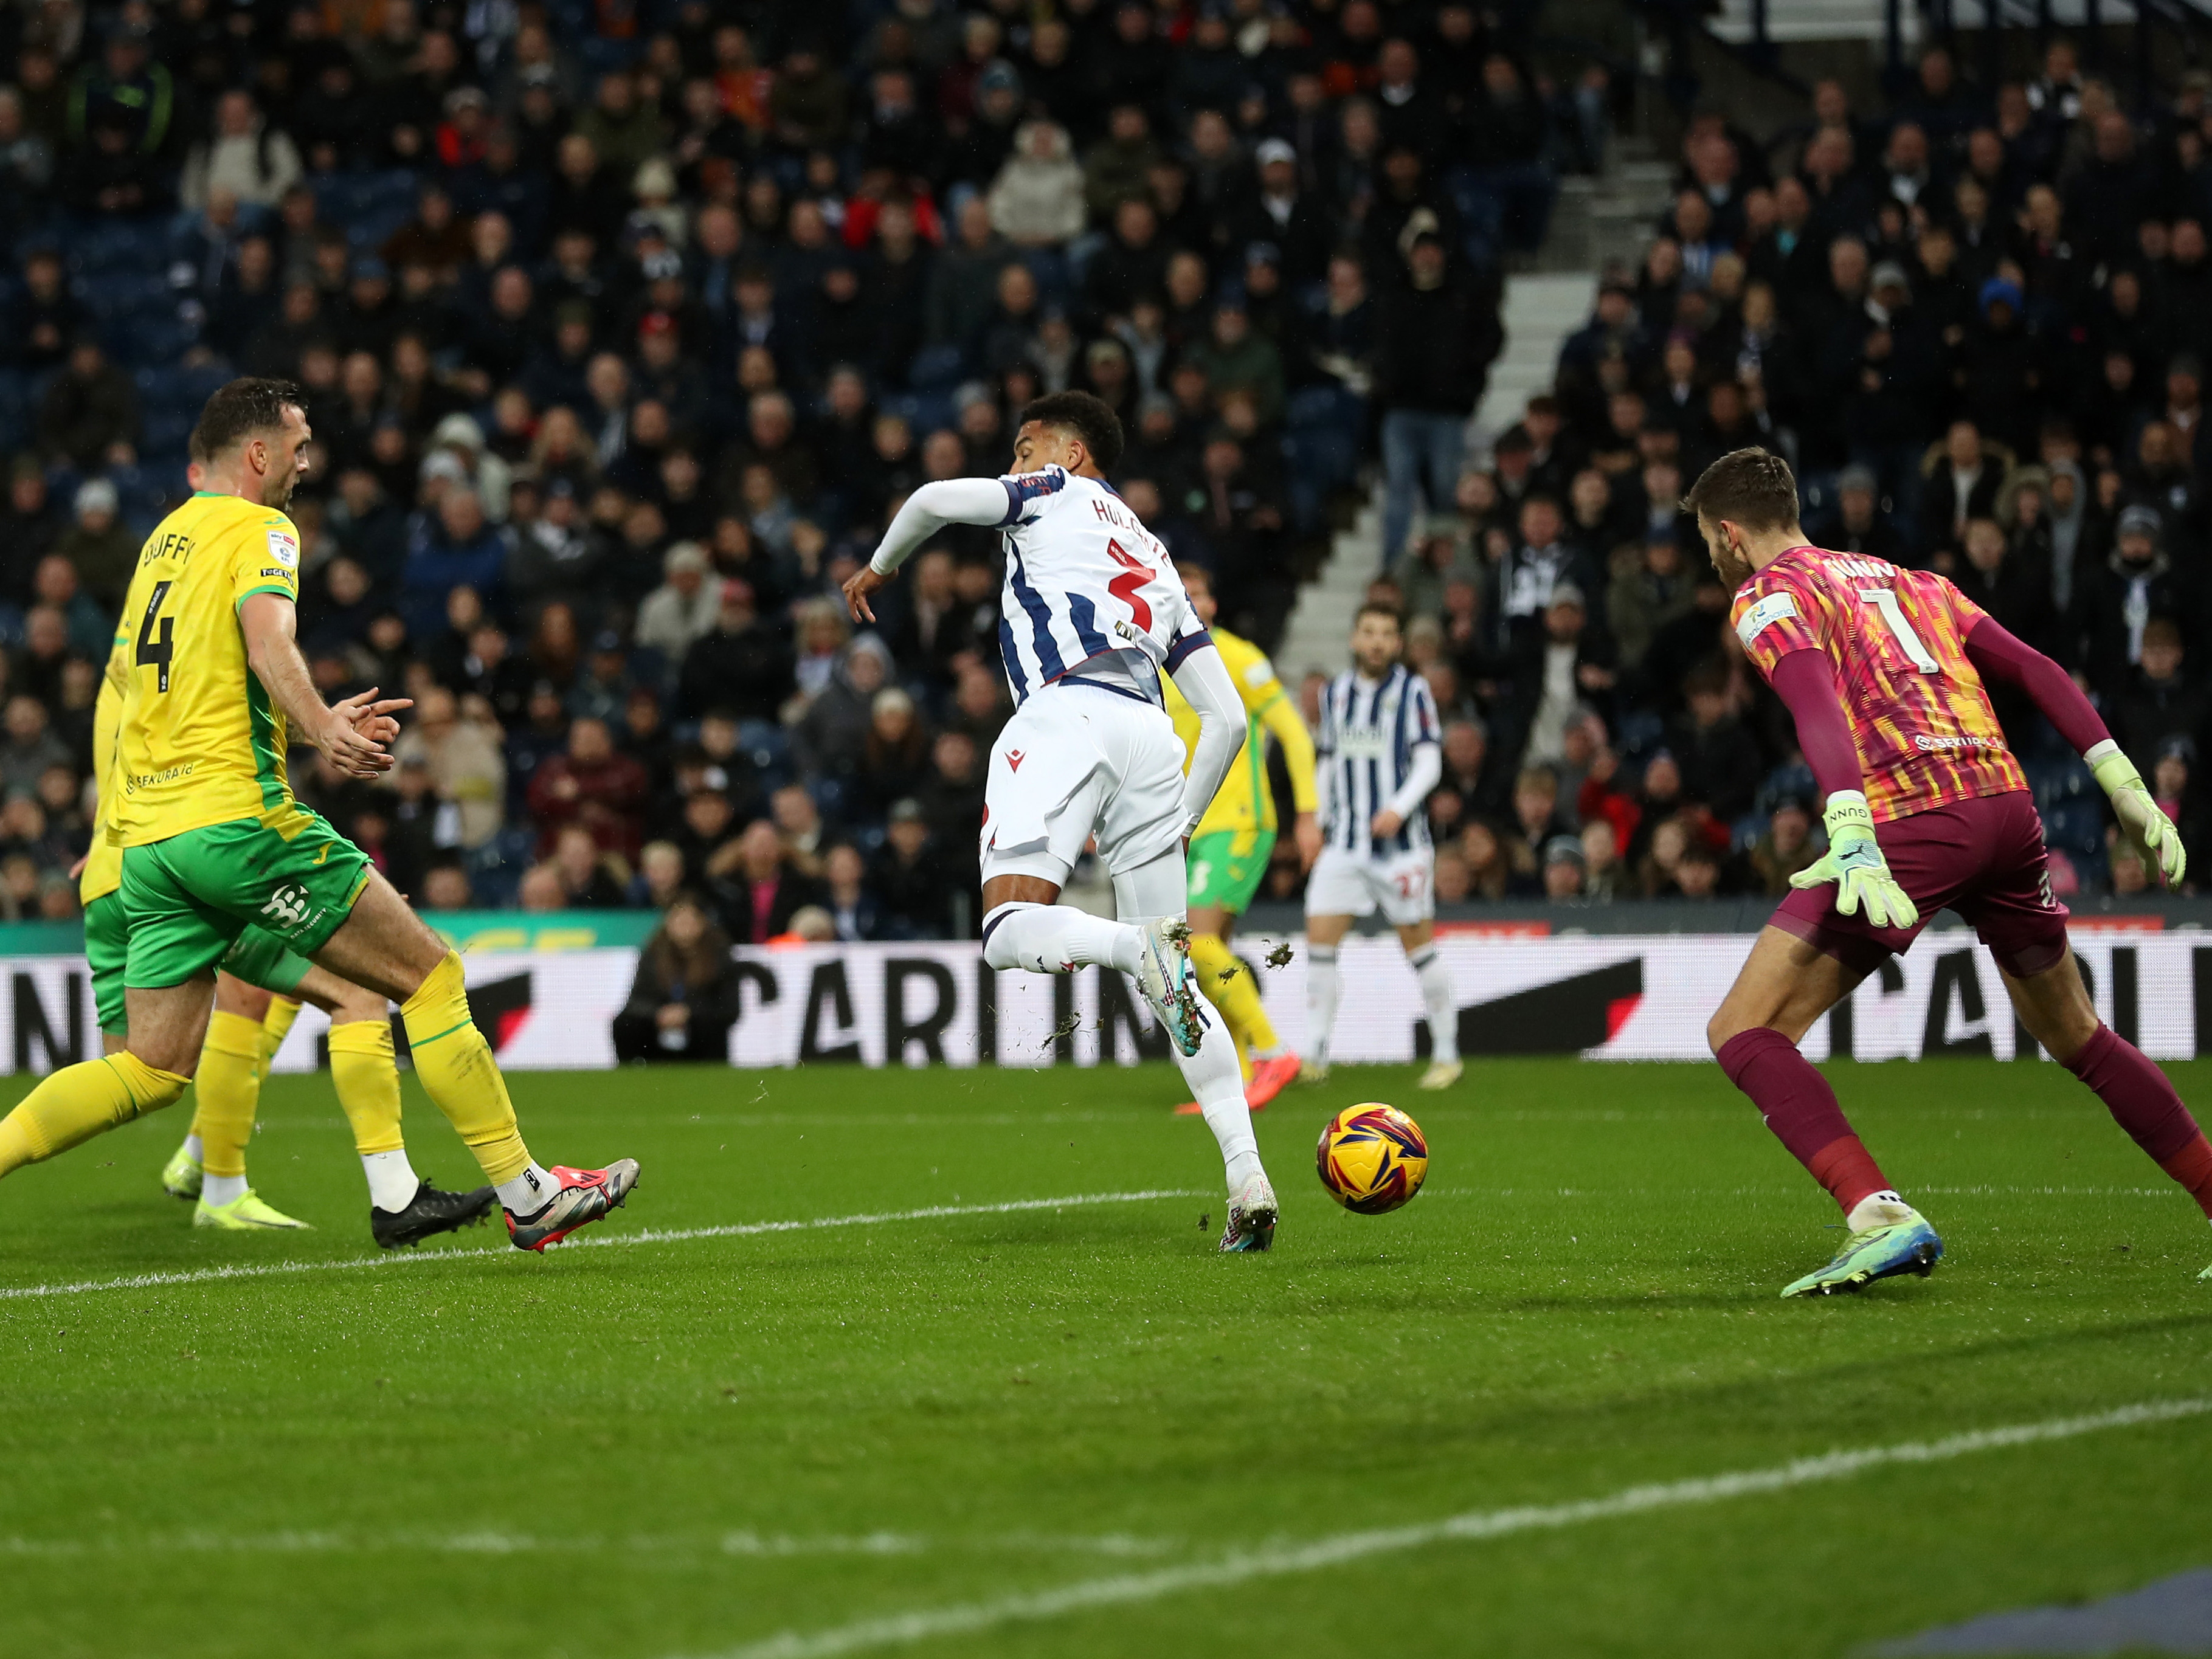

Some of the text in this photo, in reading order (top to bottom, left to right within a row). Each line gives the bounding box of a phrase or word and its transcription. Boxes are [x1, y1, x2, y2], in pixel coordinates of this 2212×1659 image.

[144, 533, 196, 567] DUFFY
[1823, 559, 1896, 579] GUNN
[136, 581, 175, 694] 4
[1855, 588, 1939, 674] 1
[1830, 807, 1868, 824] GUNN
[721, 957, 1263, 1063] CARLIN
